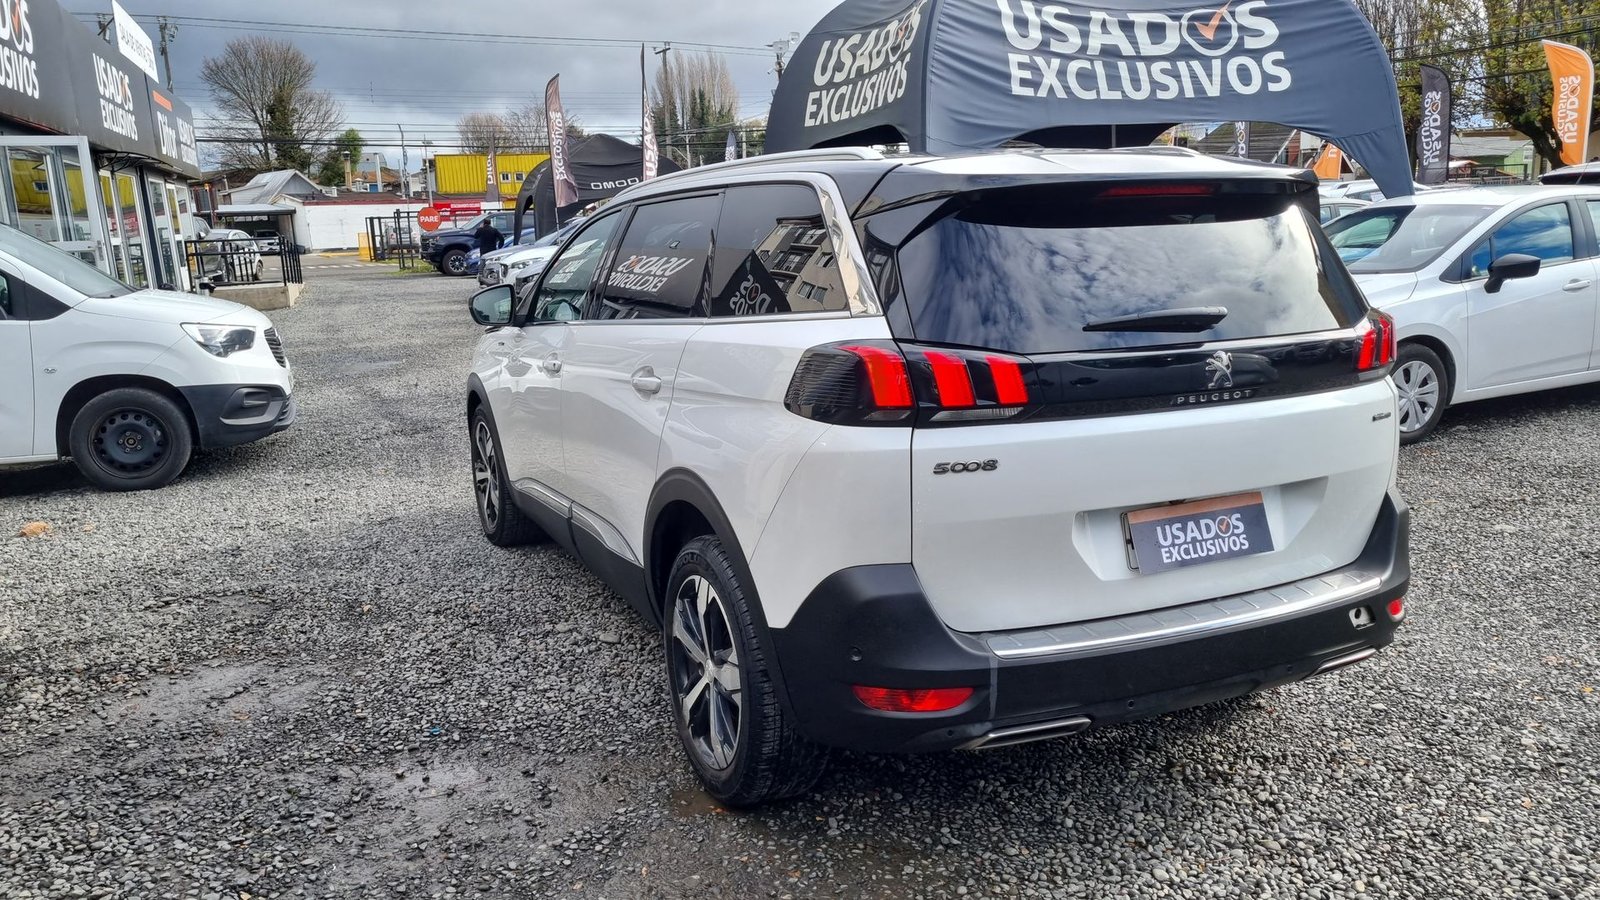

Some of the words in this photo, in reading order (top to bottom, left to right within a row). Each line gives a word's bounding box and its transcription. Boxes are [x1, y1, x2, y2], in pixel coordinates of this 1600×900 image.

[814, 0, 928, 87] USADOS
[997, 0, 1280, 56] USADOS
[93, 53, 134, 112] USADOS
[804, 52, 912, 127] EXCLUSIVOS
[1008, 51, 1291, 99] EXCLUSIVOS
[100, 98, 139, 141] EXCLUSIVOS
[555, 112, 567, 181] EXCLUSIVOS
[420, 215, 439, 223] PARE
[1177, 389, 1252, 405] PEUGEOT
[933, 459, 999, 475] 5008
[1156, 512, 1246, 549] USADOS
[1161, 533, 1250, 564] EXCLUSIVOS
